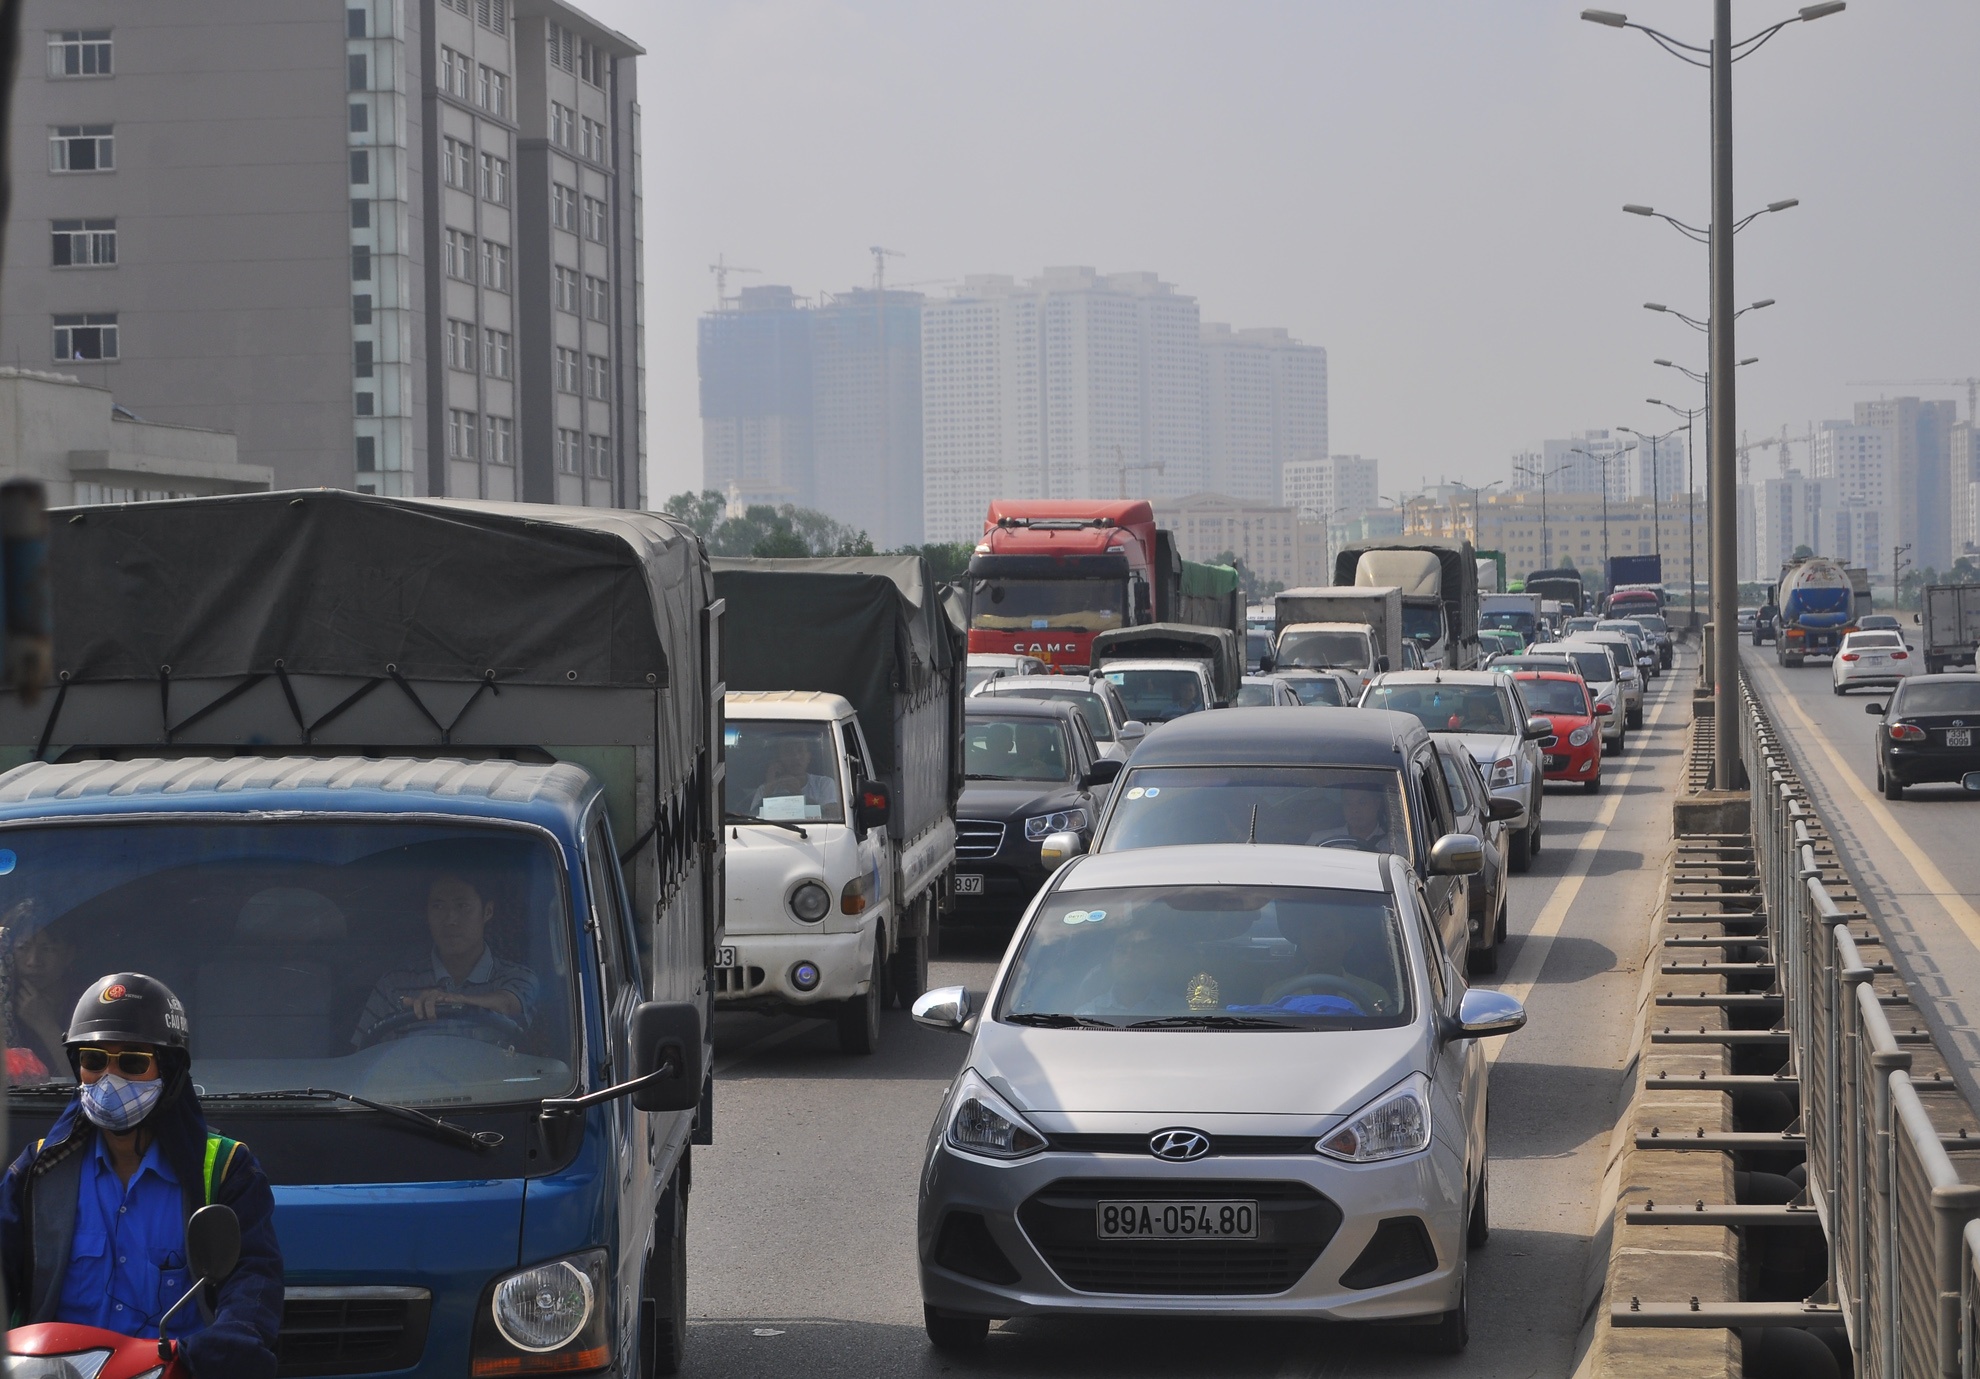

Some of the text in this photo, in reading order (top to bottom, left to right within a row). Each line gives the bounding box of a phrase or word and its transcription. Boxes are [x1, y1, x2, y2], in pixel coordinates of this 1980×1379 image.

[1013, 643, 1076, 652] CAMC
[1948, 738, 1969, 746] 6099
[955, 878, 980, 891] 8.97
[1103, 1205, 1252, 1235] 89A-054.80
